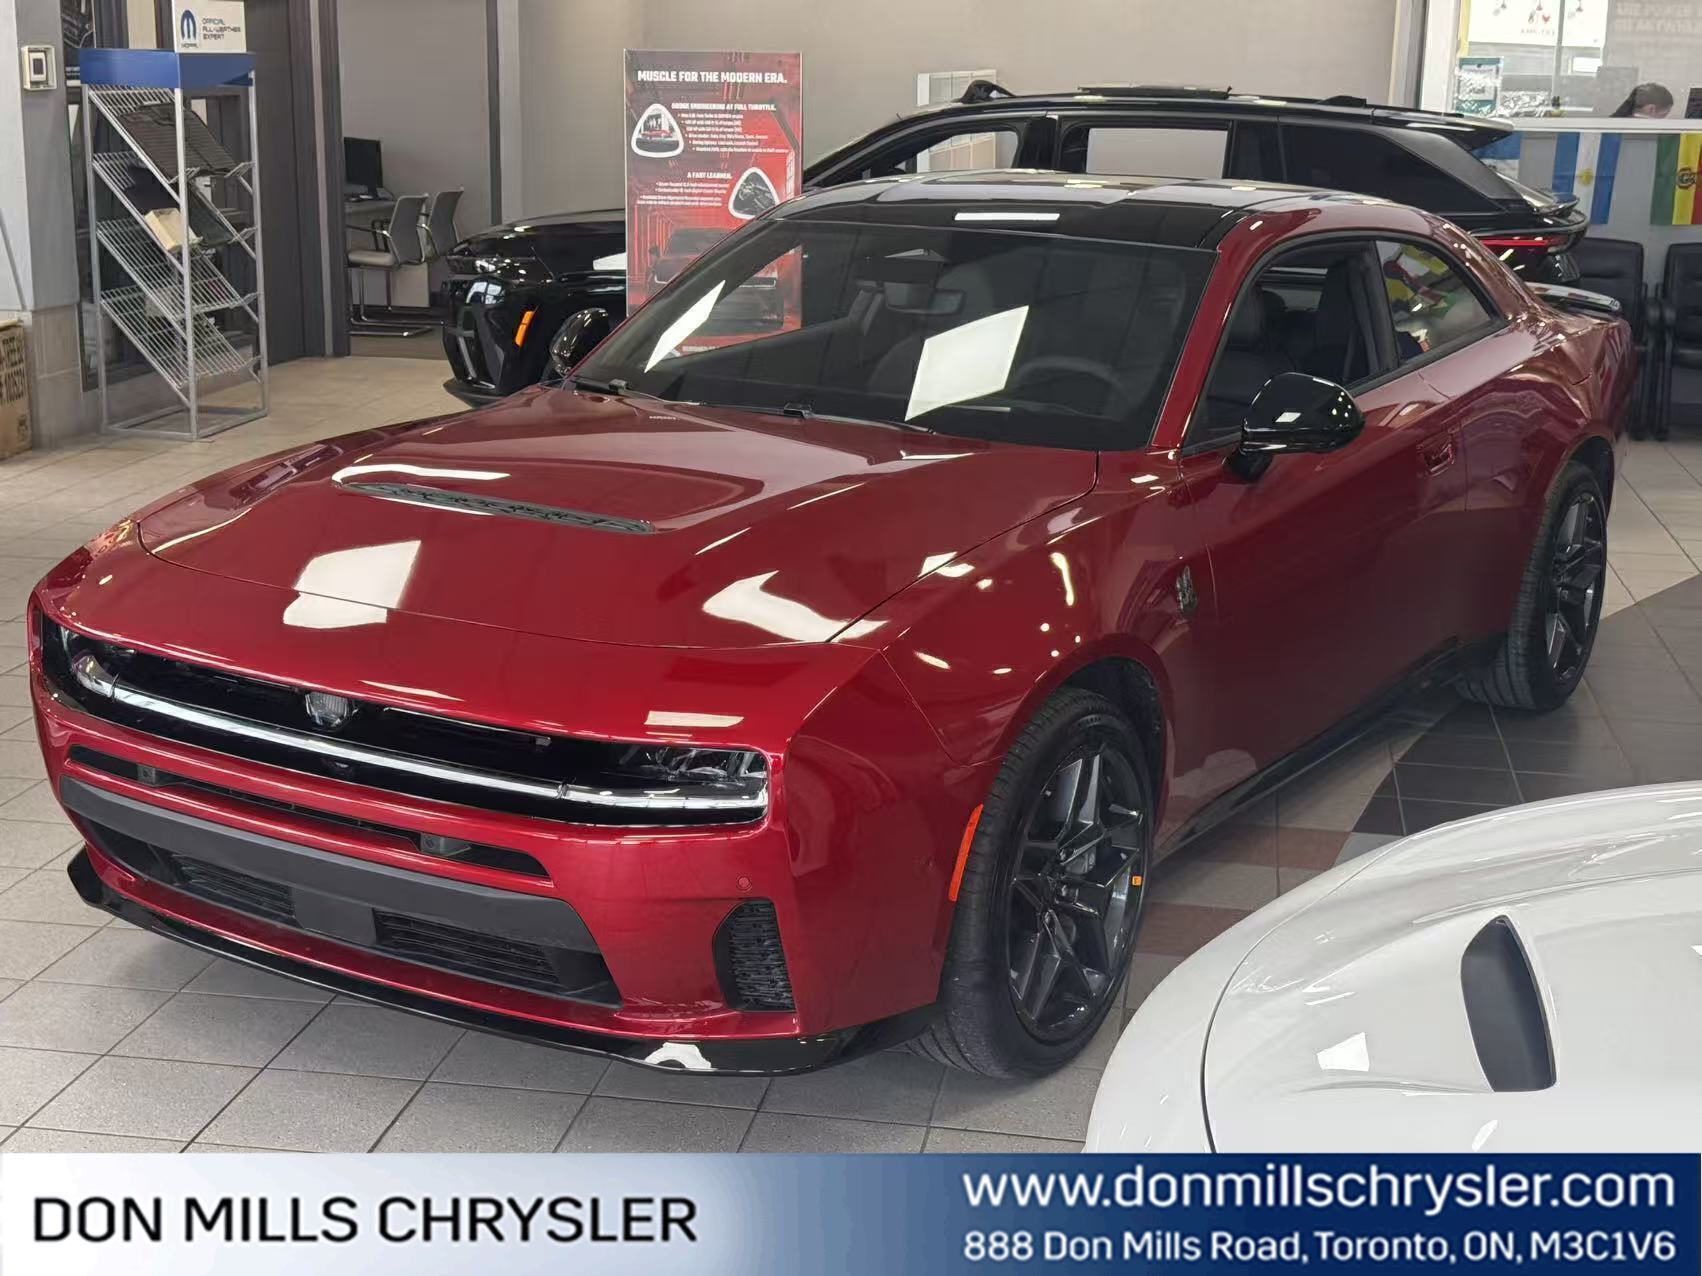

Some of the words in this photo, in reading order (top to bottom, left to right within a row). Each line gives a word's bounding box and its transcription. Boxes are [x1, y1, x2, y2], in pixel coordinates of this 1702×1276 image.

[637, 70, 677, 82] MUSCLE
[679, 71, 699, 82] FOR
[700, 71, 719, 82] THE
[721, 72, 763, 83] MODERN
[764, 72, 788, 84] ERA.
